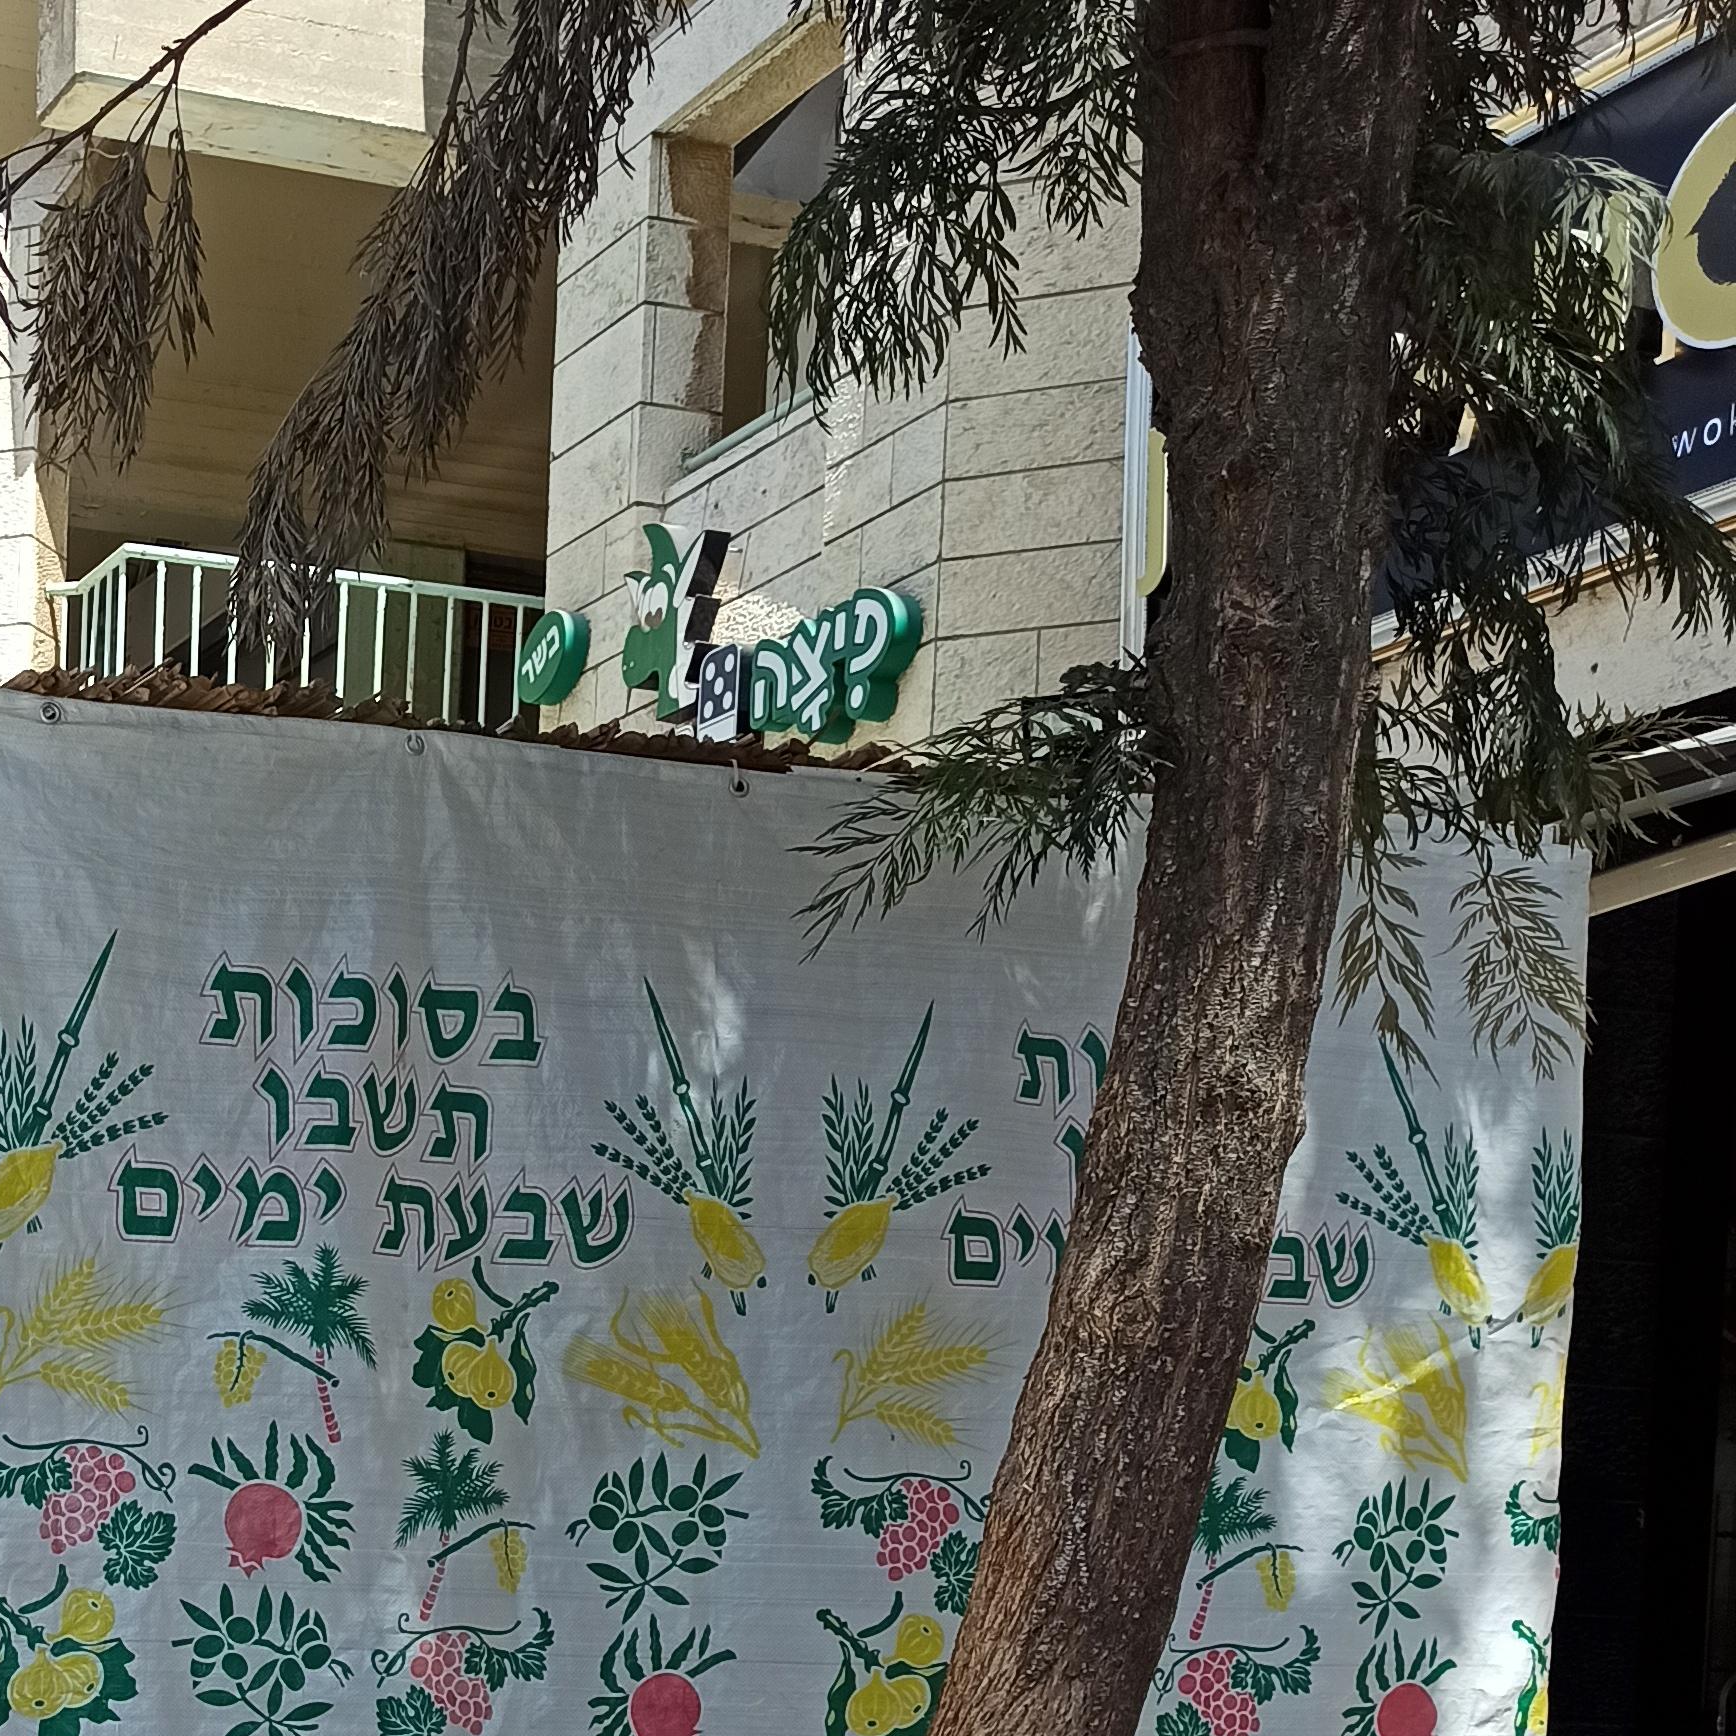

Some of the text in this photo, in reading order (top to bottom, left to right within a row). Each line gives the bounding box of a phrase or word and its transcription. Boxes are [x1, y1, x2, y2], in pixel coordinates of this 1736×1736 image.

[521, 622, 561, 685] כשר
[752, 598, 888, 732] פיצה
[202, 953, 546, 1067] בסוכות
[256, 1059, 494, 1175] תשבו
[109, 1147, 633, 1270] שבעת ימים
[942, 1197, 1374, 1309] שב ים
